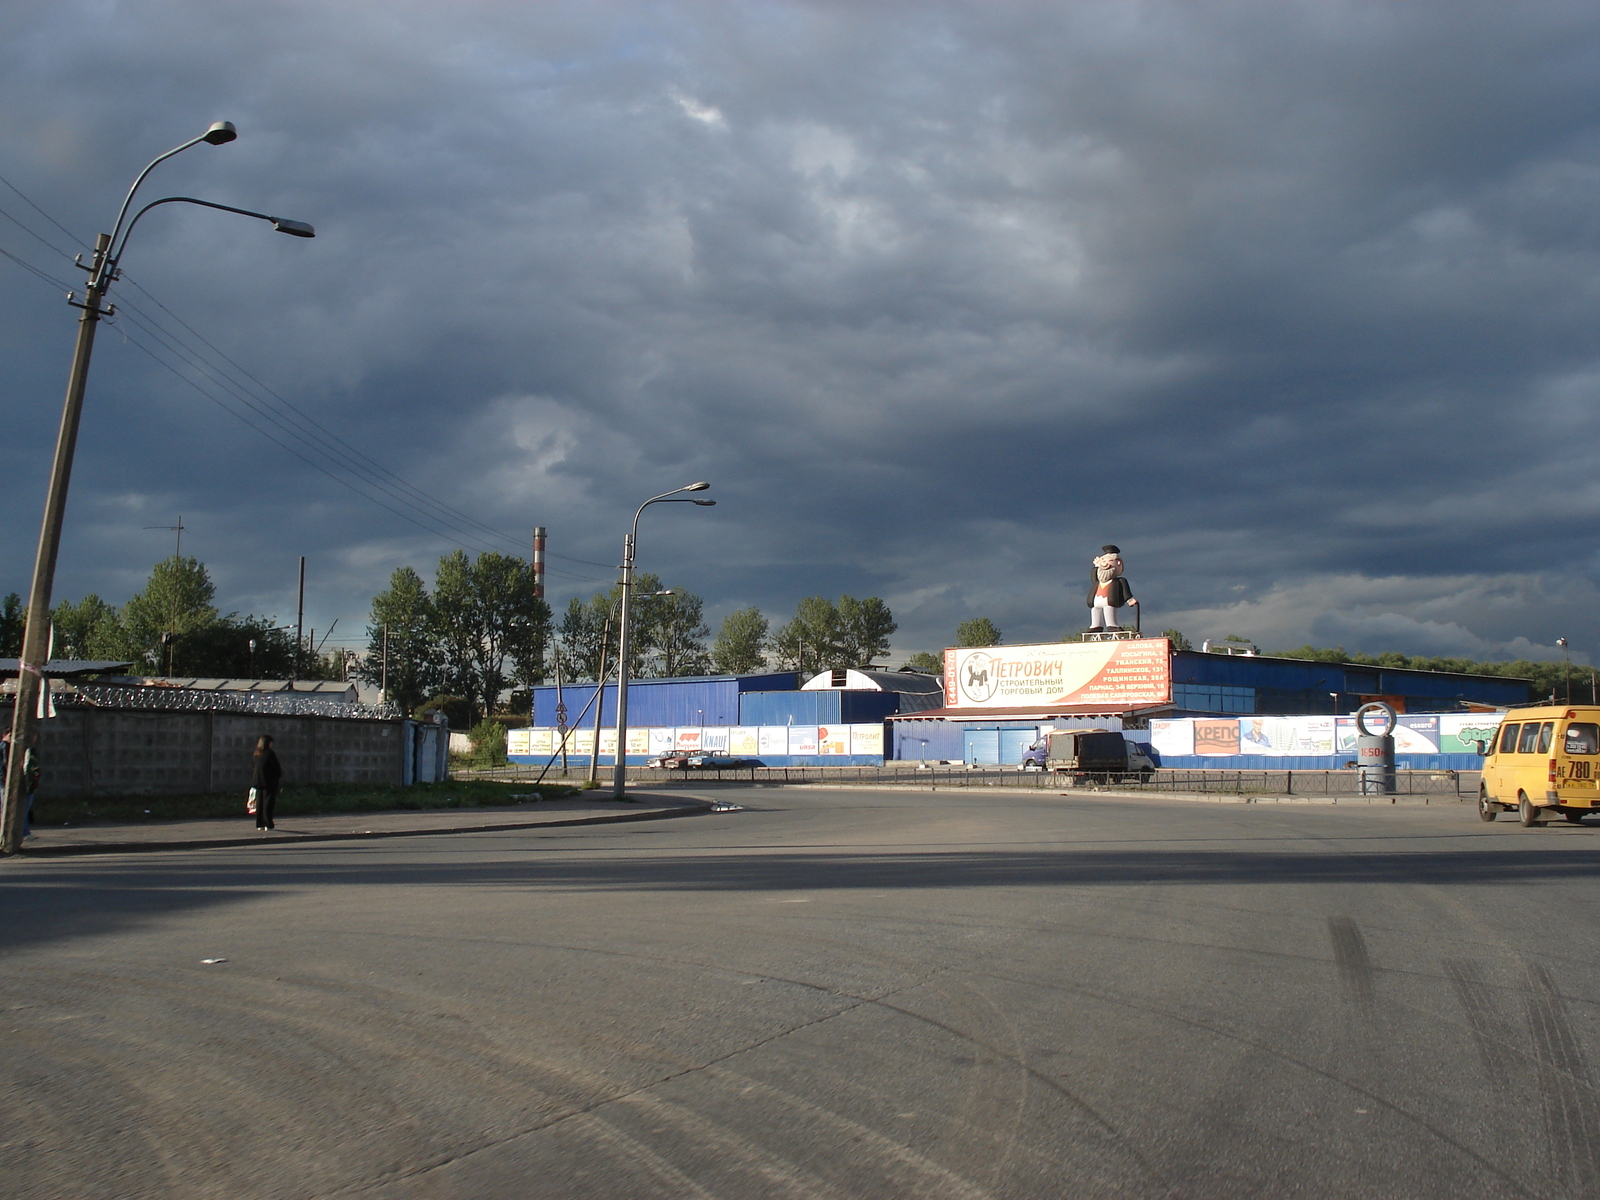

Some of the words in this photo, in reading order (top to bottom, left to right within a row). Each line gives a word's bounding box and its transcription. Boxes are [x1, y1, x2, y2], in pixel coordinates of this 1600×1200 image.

[989, 658, 1063, 678] ПЕТРОВИЧ
[1000, 678, 1063, 687] СТРОИТЕЛЬНЫЙ
[1000, 687, 1042, 695] ТОРГОВЫЙ
[704, 731, 727, 749] KNAUF
[1361, 748, 1380, 757] 1650
[1568, 761, 1590, 779] 780
